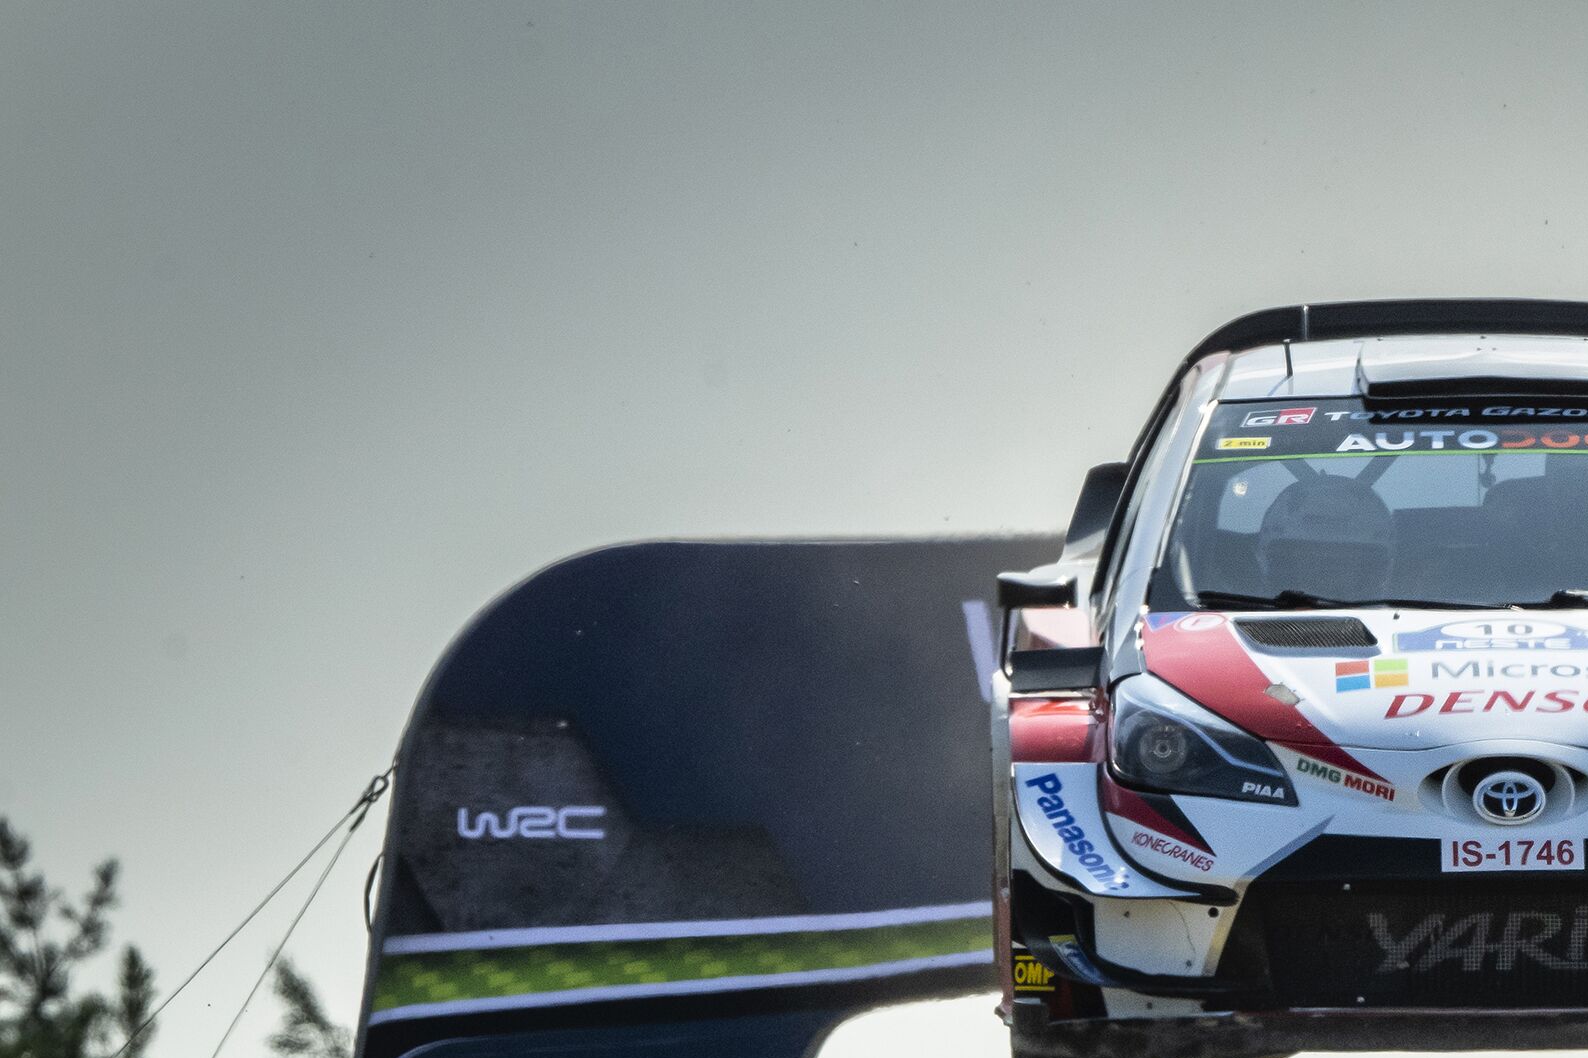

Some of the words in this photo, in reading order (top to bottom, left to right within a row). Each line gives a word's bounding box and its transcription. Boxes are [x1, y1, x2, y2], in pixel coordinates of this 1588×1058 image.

[1324, 408, 1470, 421] TOYOTA
[1475, 623, 1534, 635] 10
[1241, 782, 1285, 800] PIAA
[1296, 758, 1341, 785] DMG
[1343, 773, 1396, 801] MORI
[1131, 831, 1215, 873] KONECRANES
[1452, 839, 1576, 868] IS-1746
[1015, 961, 1055, 985] OMP
